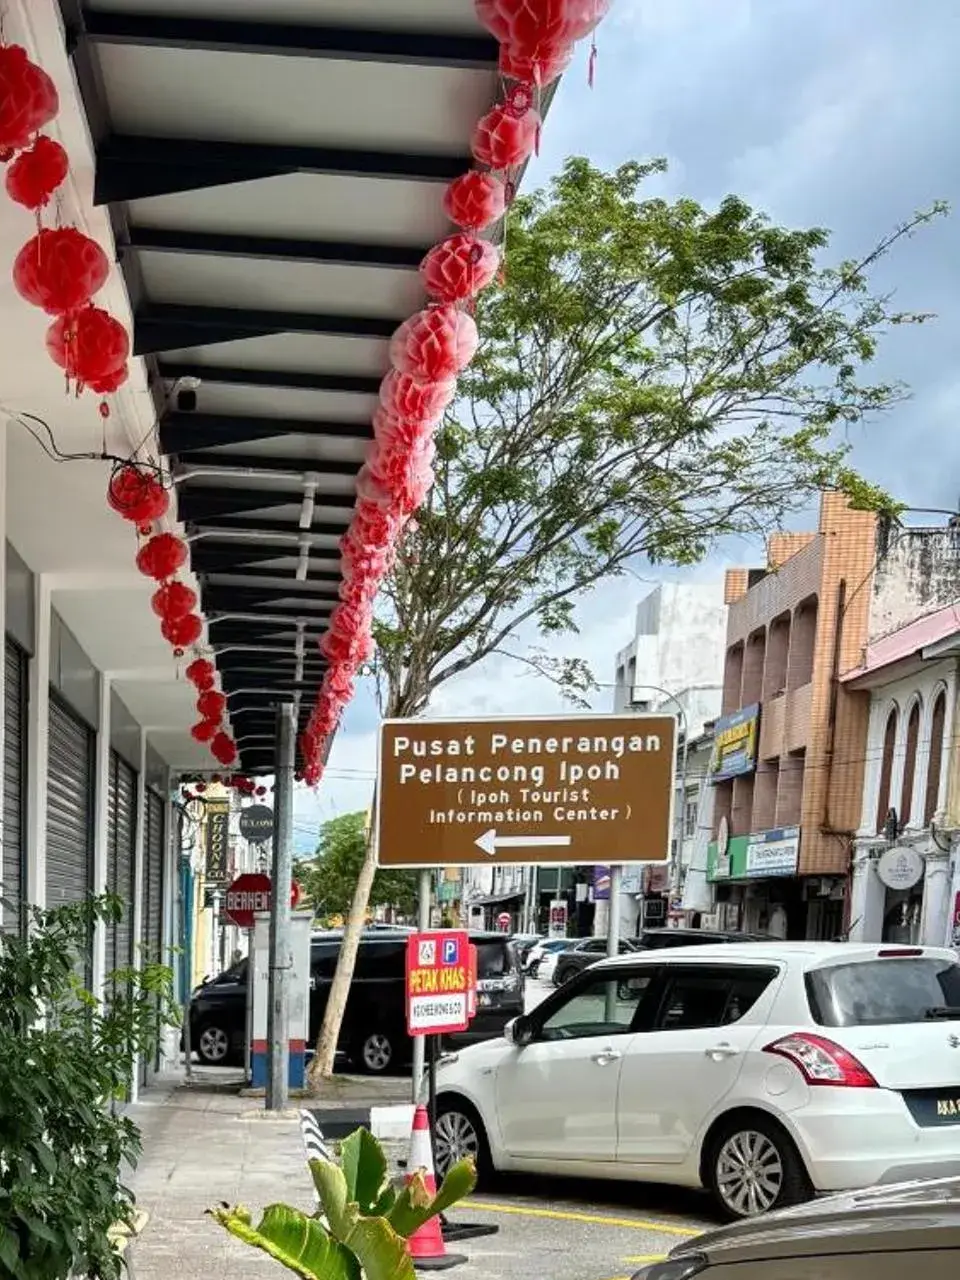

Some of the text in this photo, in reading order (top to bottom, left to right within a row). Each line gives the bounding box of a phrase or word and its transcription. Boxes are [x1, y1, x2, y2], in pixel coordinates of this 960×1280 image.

[394, 733, 661, 758] Pusat Penerangan
[399, 760, 620, 787] Pelancong Ipoh
[520, 788, 590, 803] Tourist
[429, 808, 543, 824] Information
[227, 890, 272, 911] BERHEN
